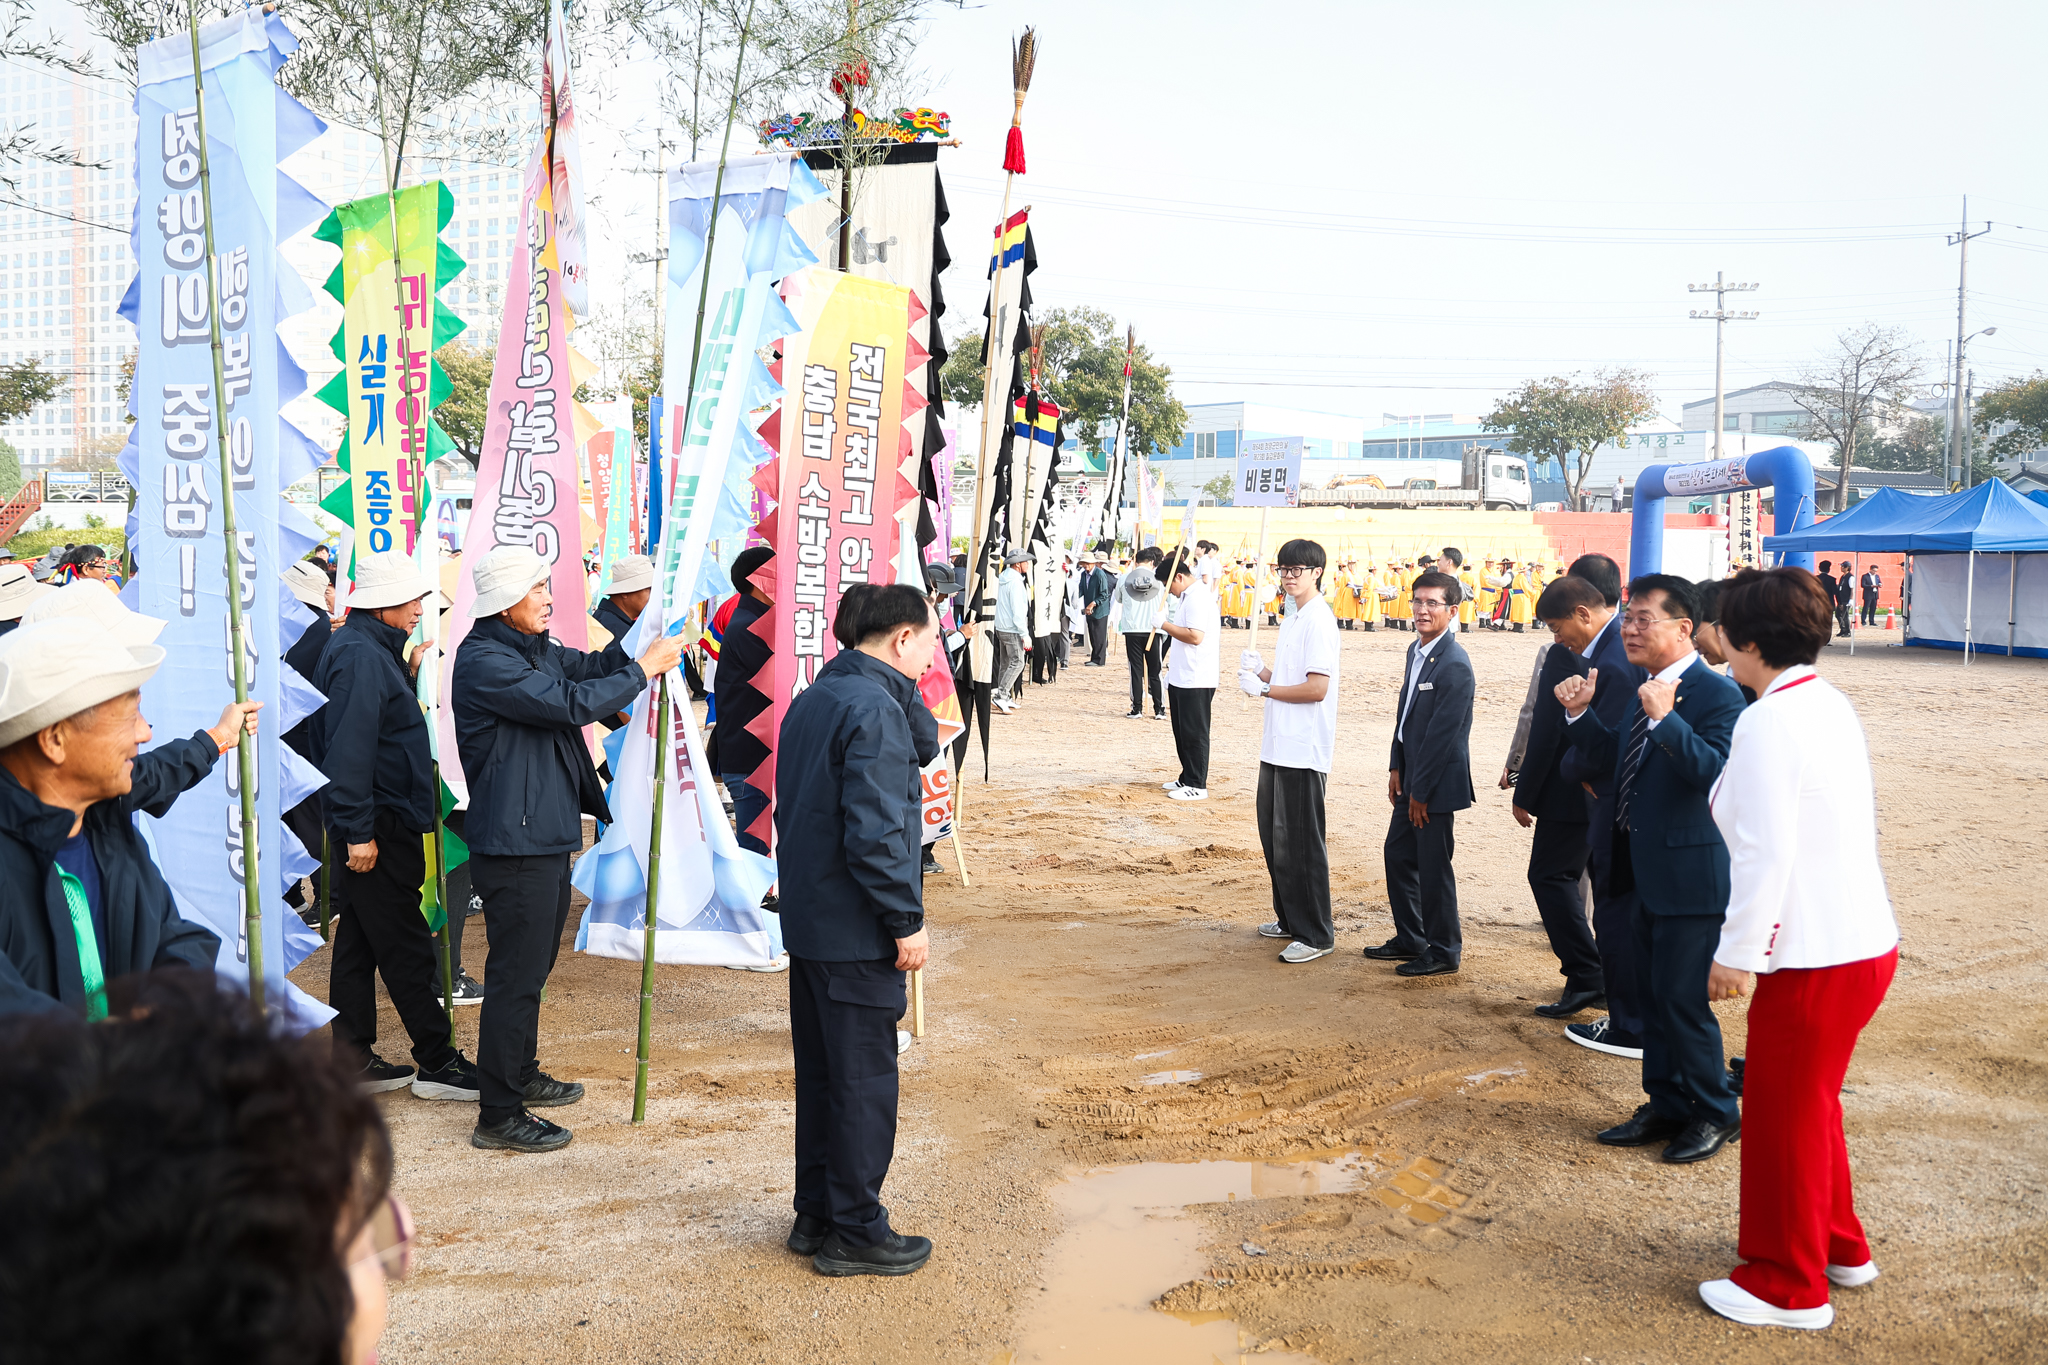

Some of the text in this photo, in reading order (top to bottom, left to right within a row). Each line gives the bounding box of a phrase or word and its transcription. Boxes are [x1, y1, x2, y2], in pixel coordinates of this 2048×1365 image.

[358, 334, 388, 446] 살기
[802, 364, 838, 461] 충남
[841, 342, 886, 526] 전국최고
[1245, 468, 1287, 493] 비봉면
